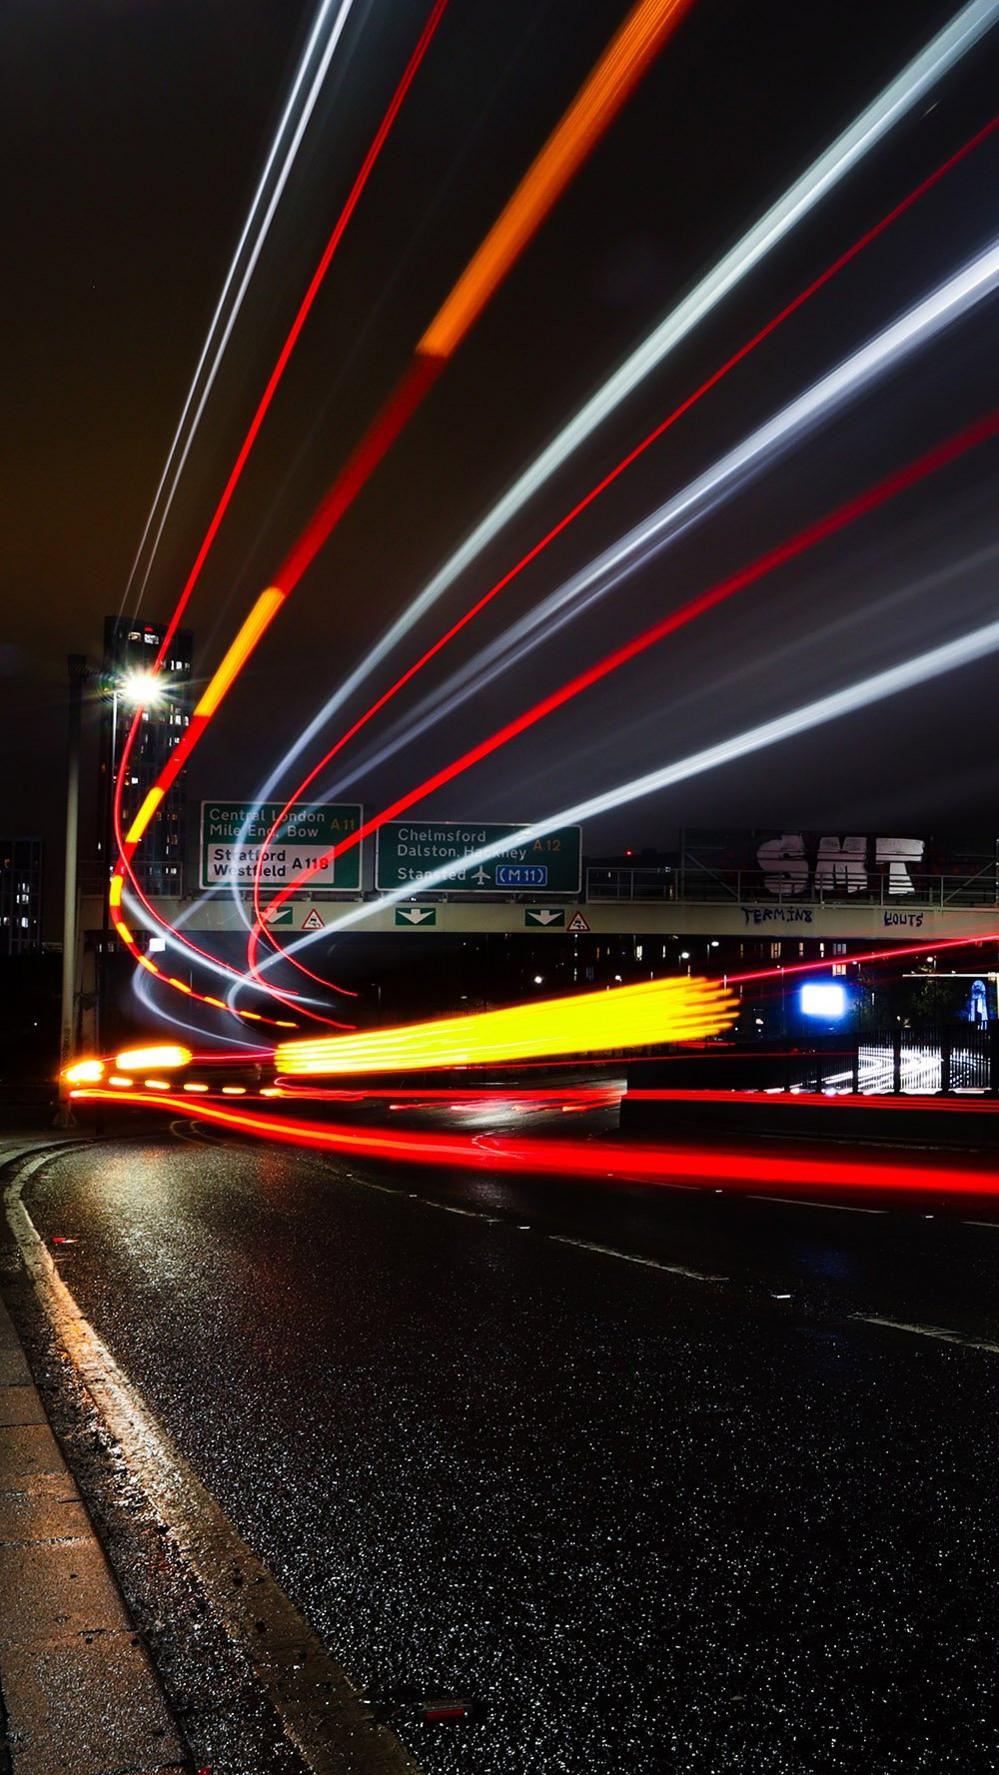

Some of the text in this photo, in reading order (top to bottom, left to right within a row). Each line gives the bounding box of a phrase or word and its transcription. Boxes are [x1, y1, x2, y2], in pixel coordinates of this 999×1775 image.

[331, 818, 355, 830] A11
[209, 824, 241, 837] Mile
[287, 826, 319, 838] Bow
[398, 828, 487, 842] Chelmsford
[397, 844, 460, 857] Dalston,
[533, 839, 561, 851] A12
[214, 848, 286, 862] Statford
[292, 857, 329, 870] A118
[397, 867, 466, 880] Staned
[499, 869, 544, 884] (M11)
